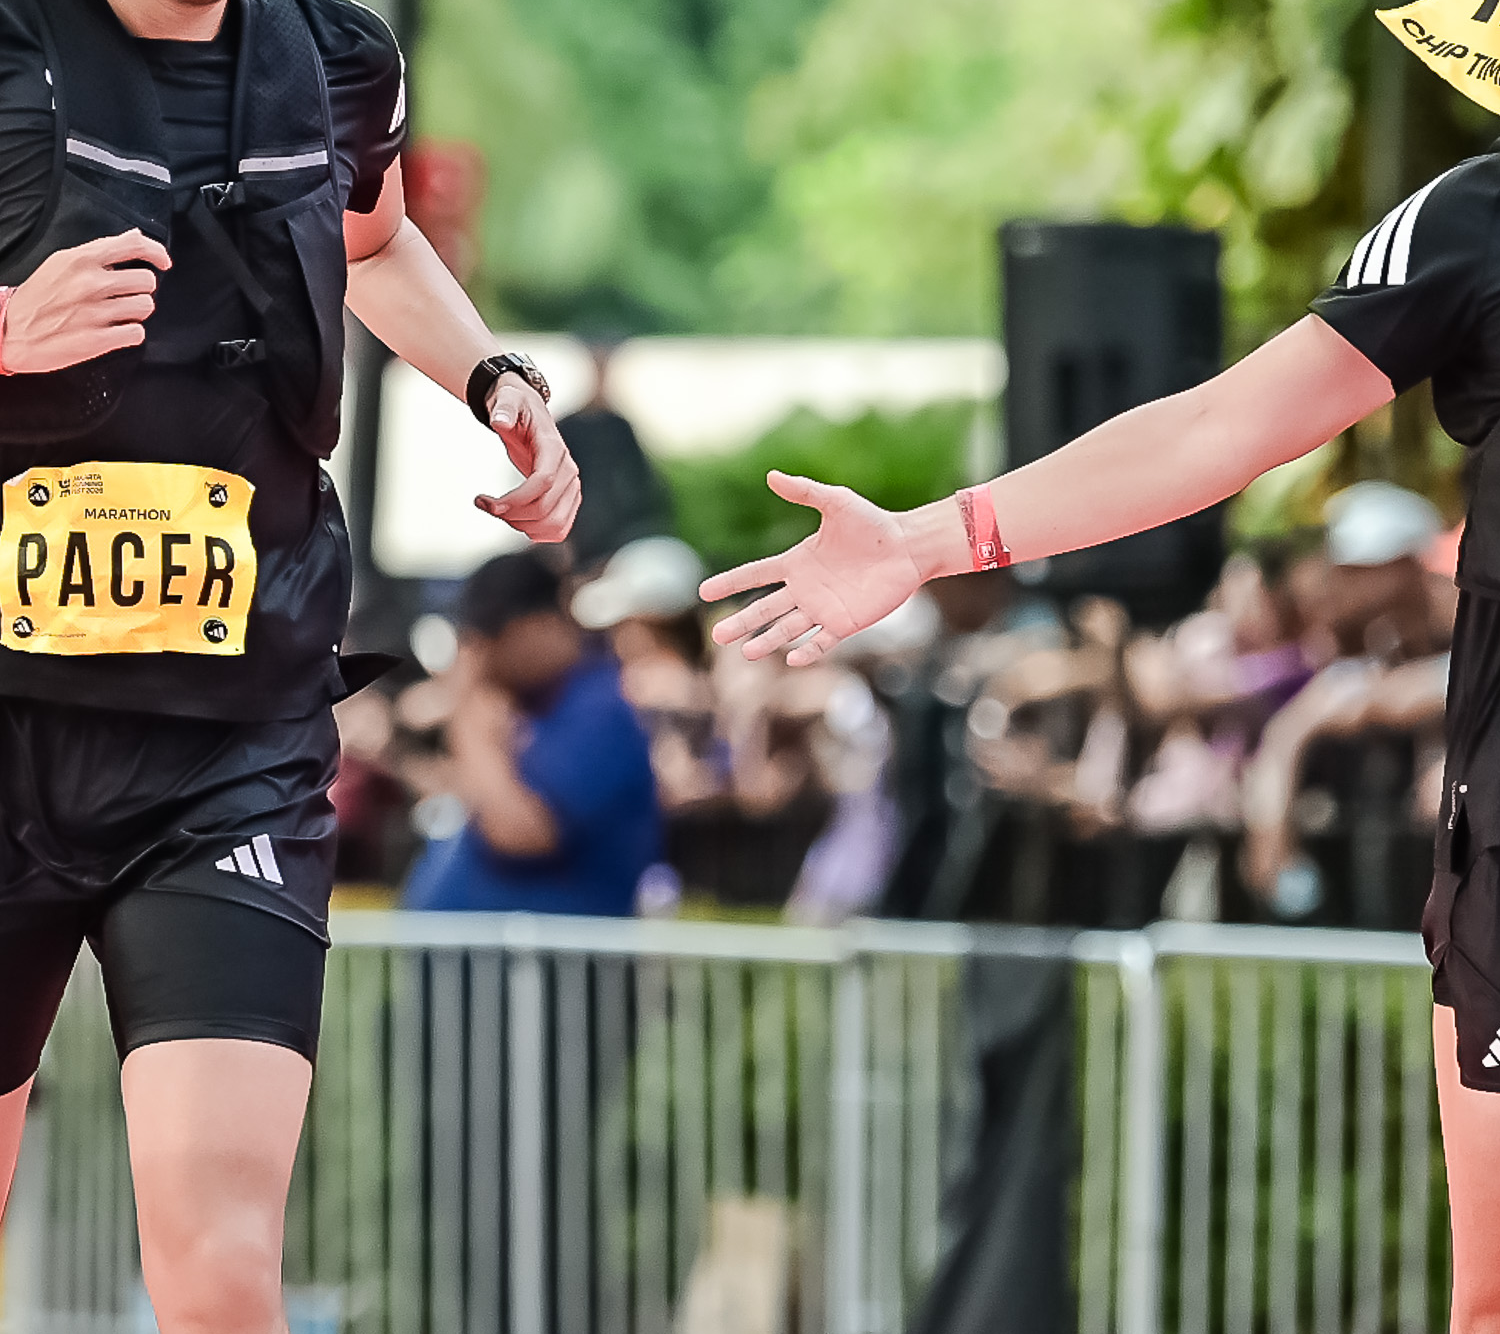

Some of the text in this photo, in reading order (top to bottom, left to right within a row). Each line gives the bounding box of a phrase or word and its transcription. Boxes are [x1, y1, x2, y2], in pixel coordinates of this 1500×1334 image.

[1401, 17, 1469, 60] CHIP
[84, 508, 171, 521] MARATHON
[17, 531, 235, 608] PACER
